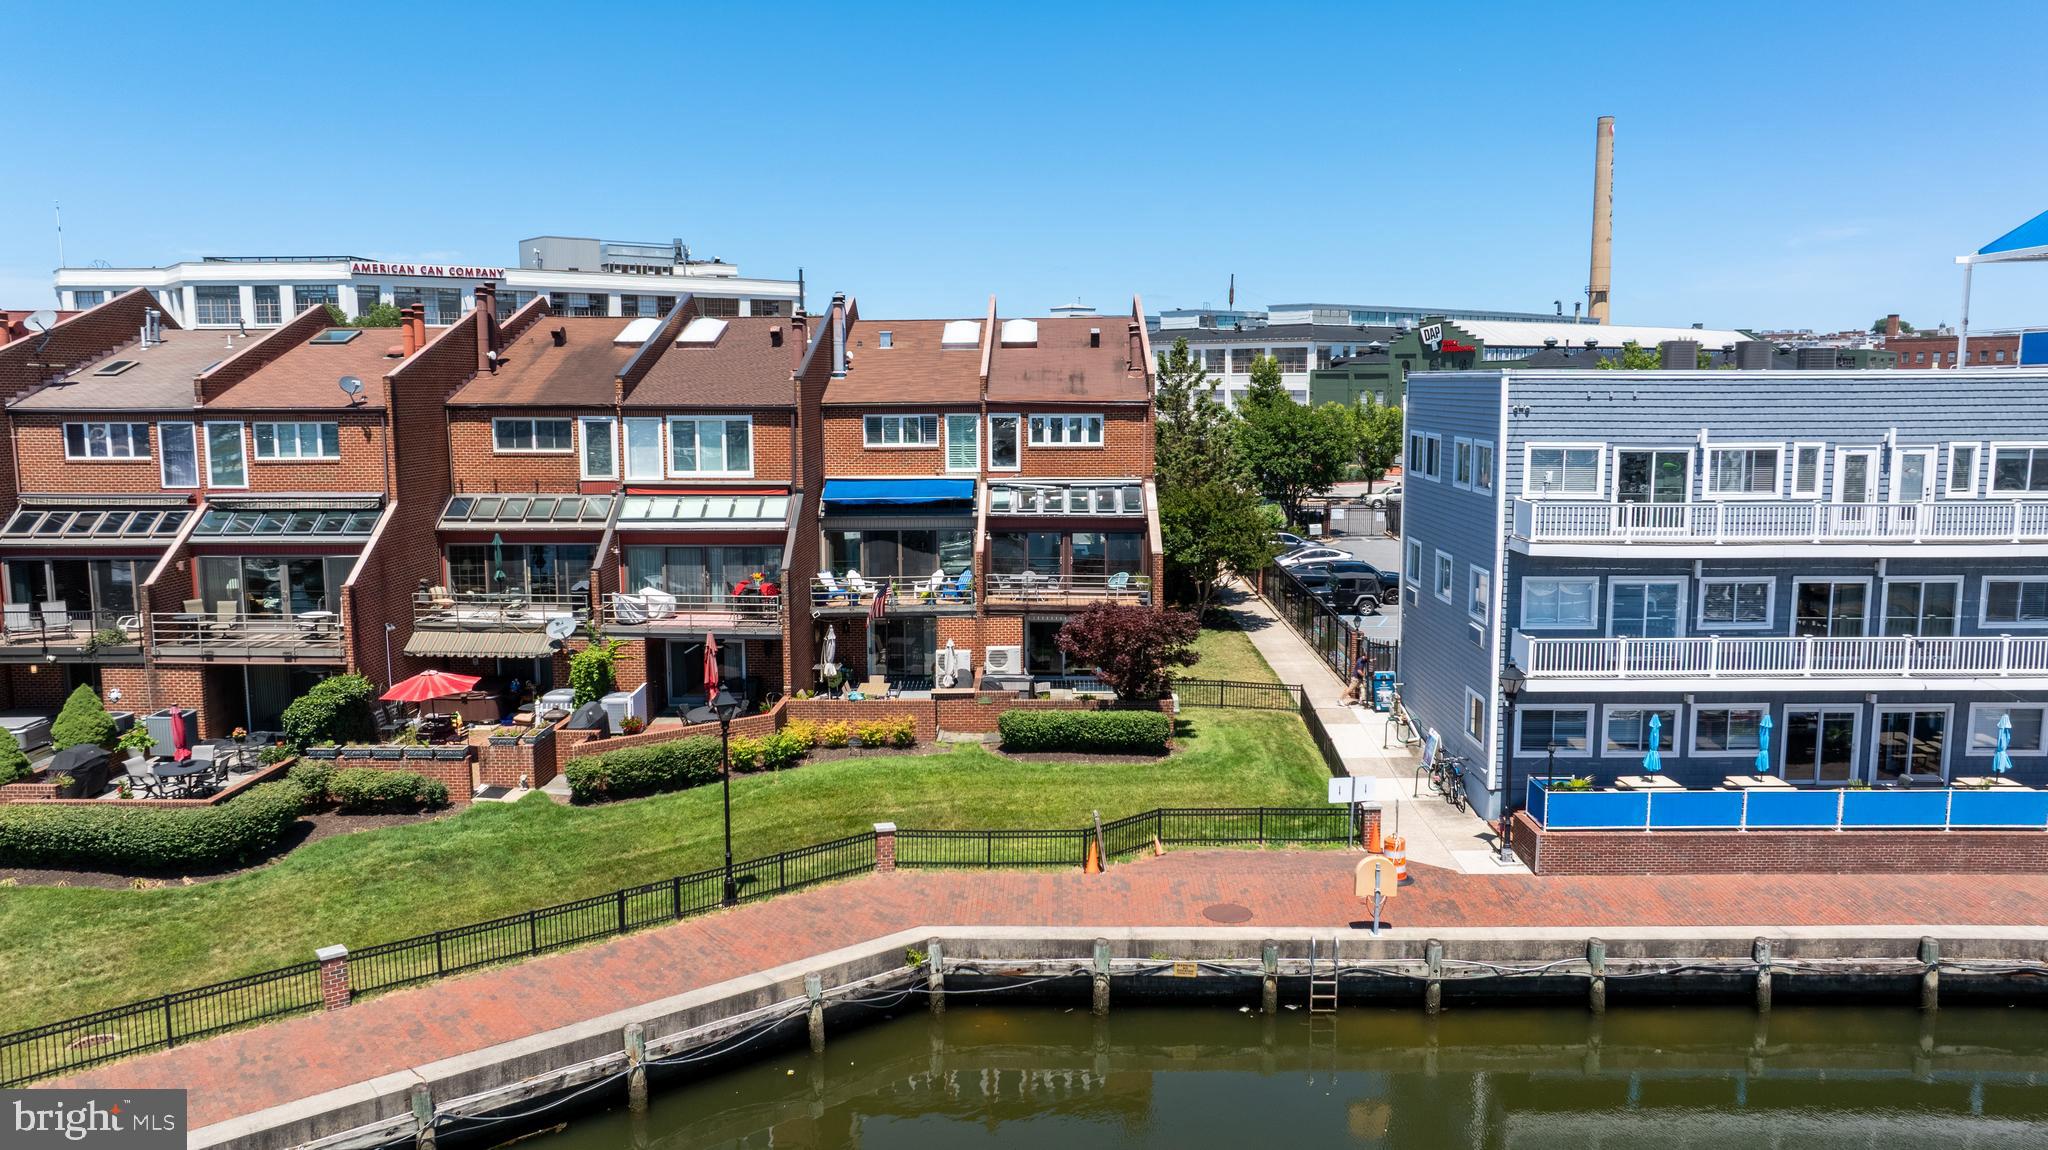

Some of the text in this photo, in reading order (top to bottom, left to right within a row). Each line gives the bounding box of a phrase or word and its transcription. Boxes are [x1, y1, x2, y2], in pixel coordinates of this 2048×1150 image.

[352, 263, 504, 278] AMERICAN CAN COMPANY
[1423, 326, 1441, 341] DAP
